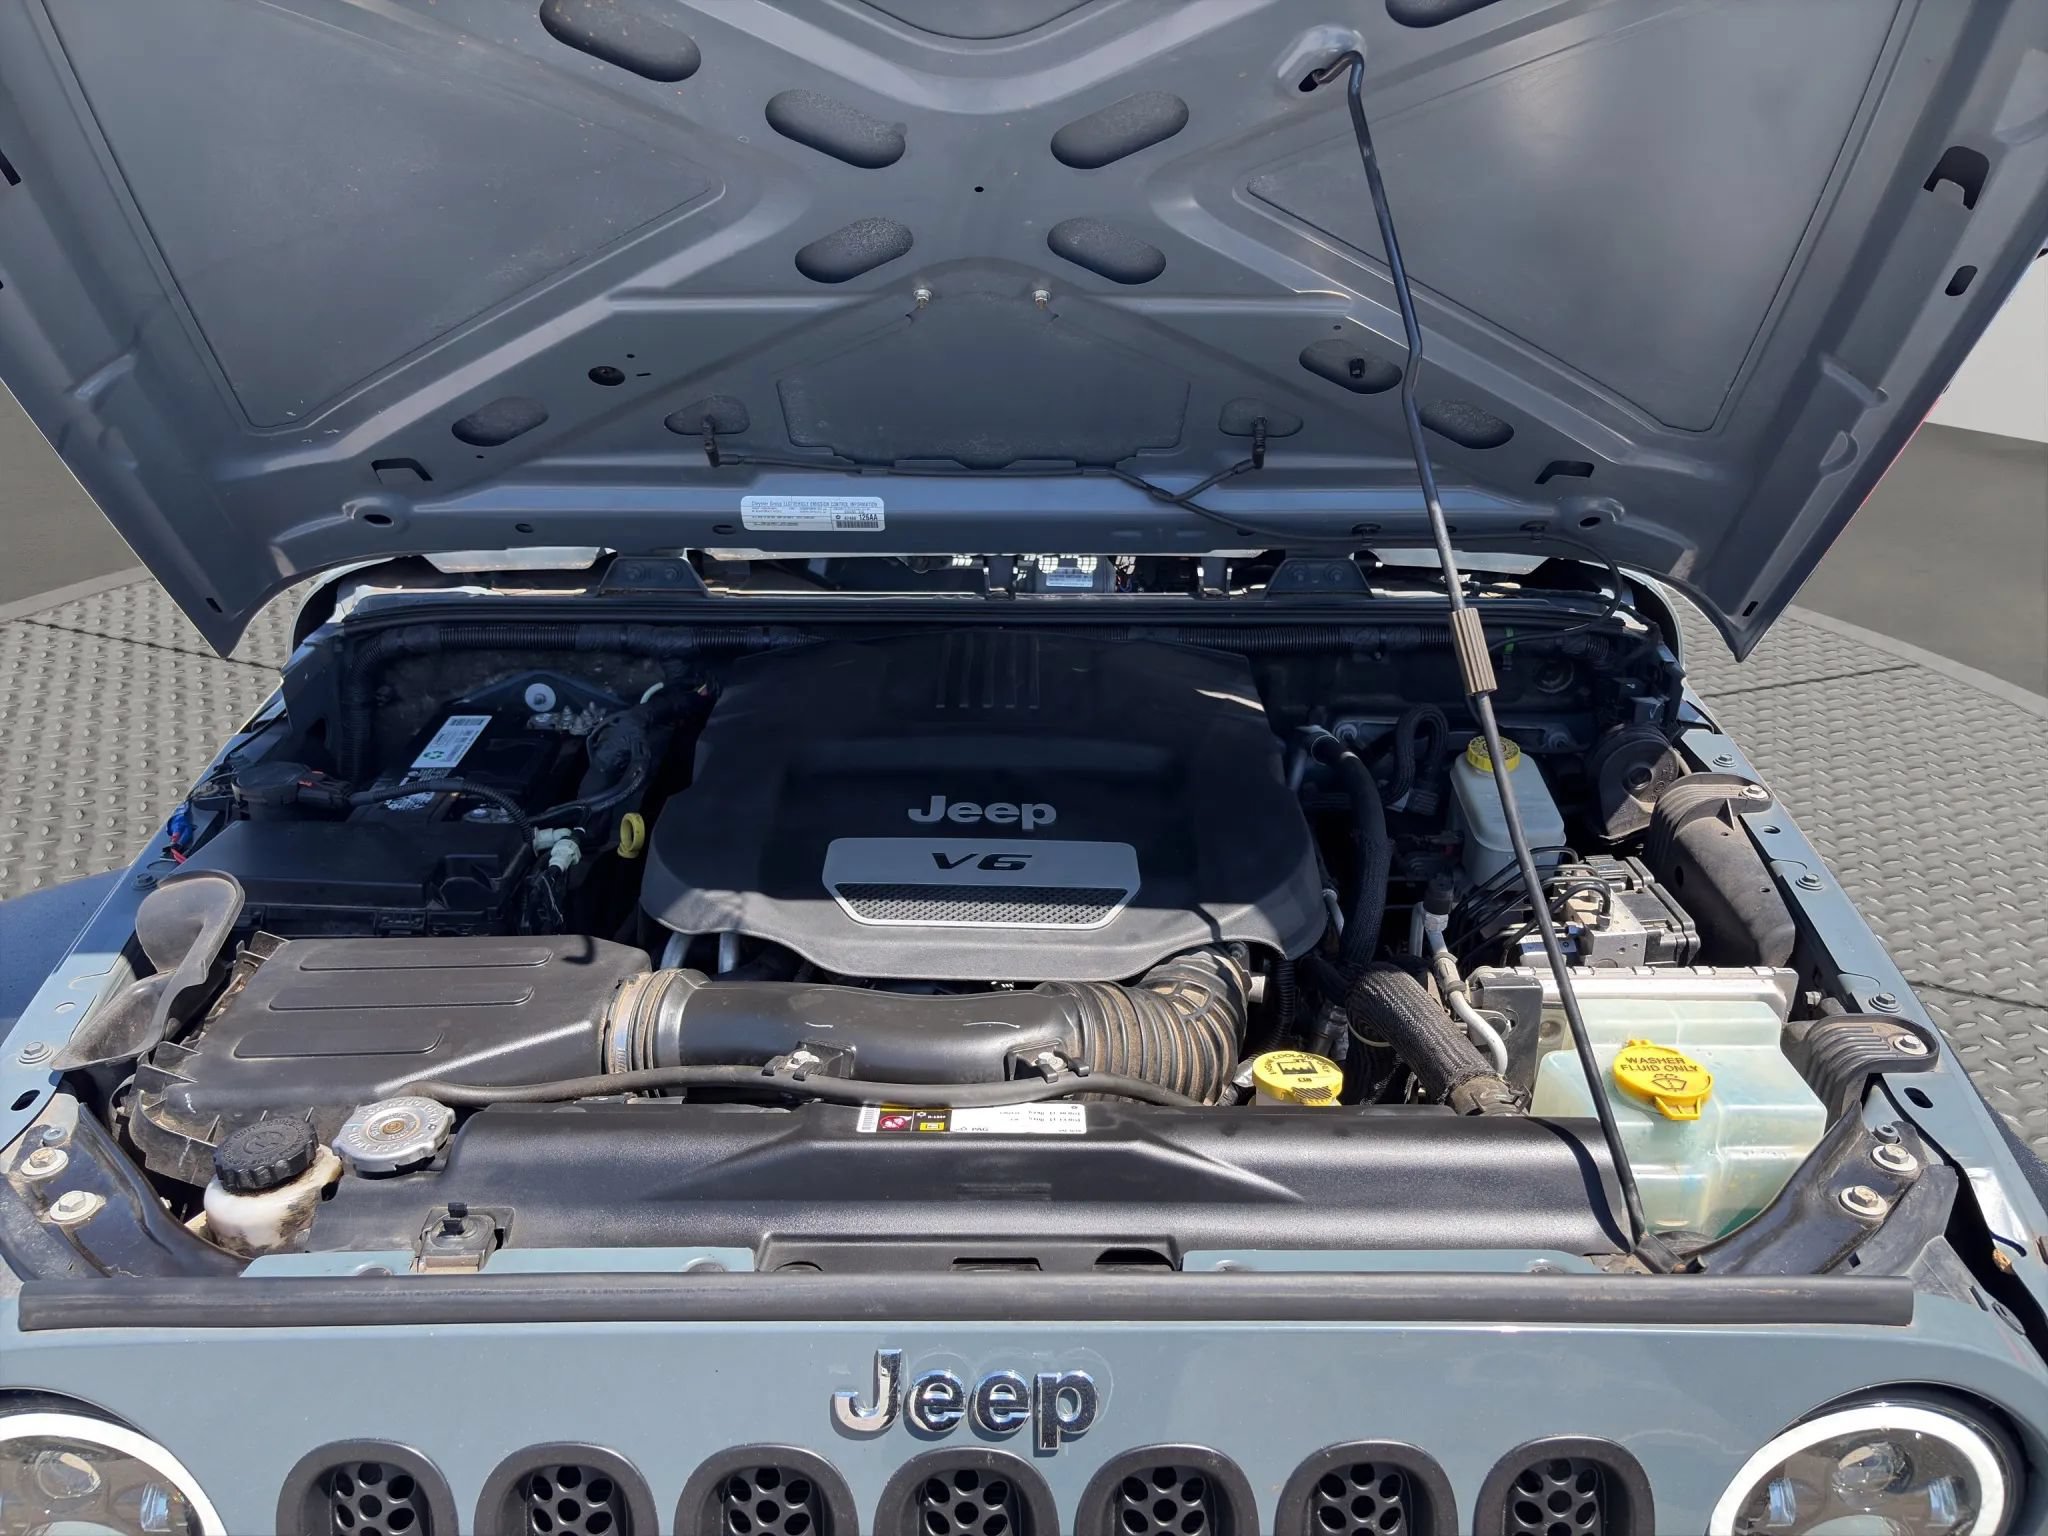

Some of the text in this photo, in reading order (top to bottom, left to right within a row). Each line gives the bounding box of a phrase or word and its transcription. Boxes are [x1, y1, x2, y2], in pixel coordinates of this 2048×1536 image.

[907, 794, 1057, 832] Jeep
[931, 851, 1034, 871] V6
[1620, 1064, 1699, 1073] FLUID ONLY
[833, 1347, 1099, 1451] Jeep
